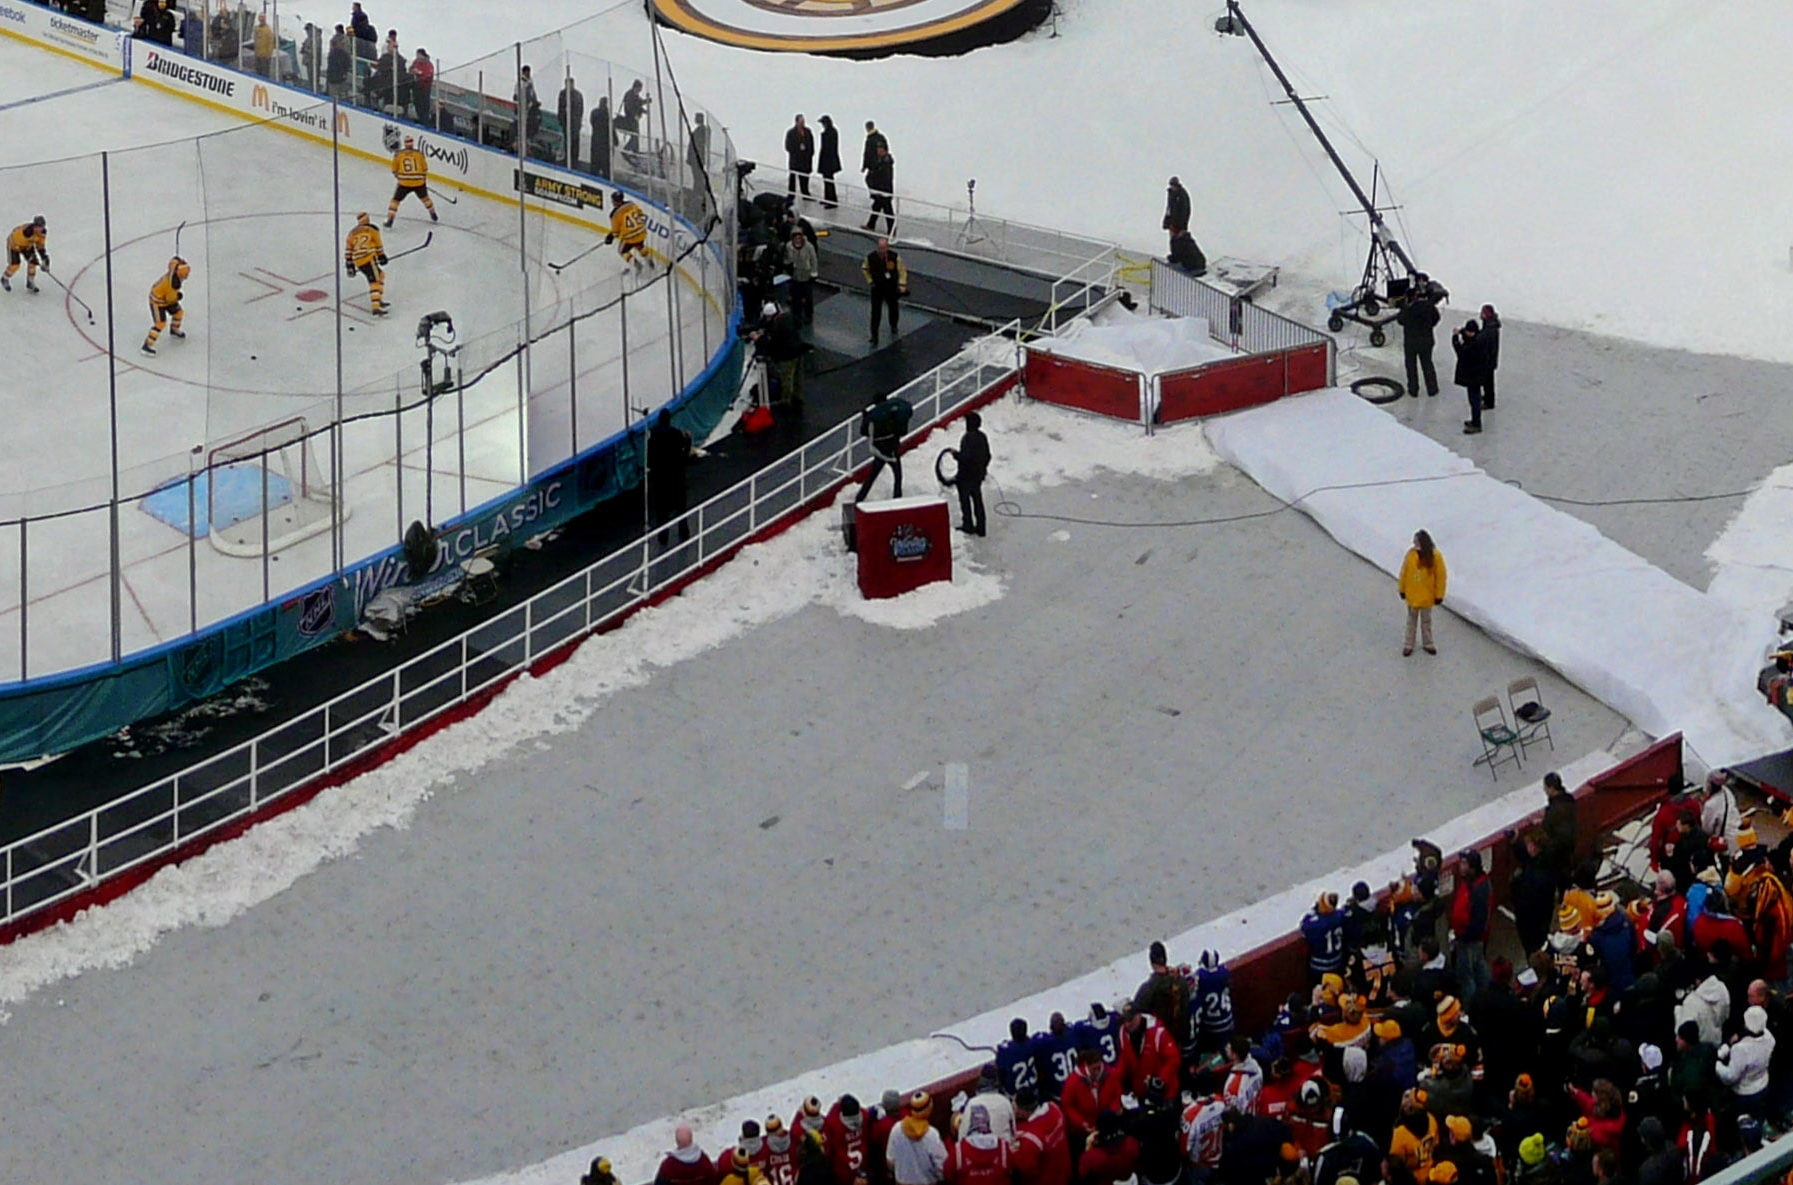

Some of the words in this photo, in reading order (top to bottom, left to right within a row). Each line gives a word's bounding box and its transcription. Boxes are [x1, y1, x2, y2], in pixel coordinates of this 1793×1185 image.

[49, 16, 100, 42] ticketmaster
[145, 50, 236, 99] BRIDGESTONE
[271, 100, 289, 116] i'm
[319, 117, 328, 132] it
[401, 157, 419, 174] 61
[534, 177, 563, 195] ARMY
[563, 184, 603, 206] STRONG
[454, 482, 562, 556] CLASSIC
